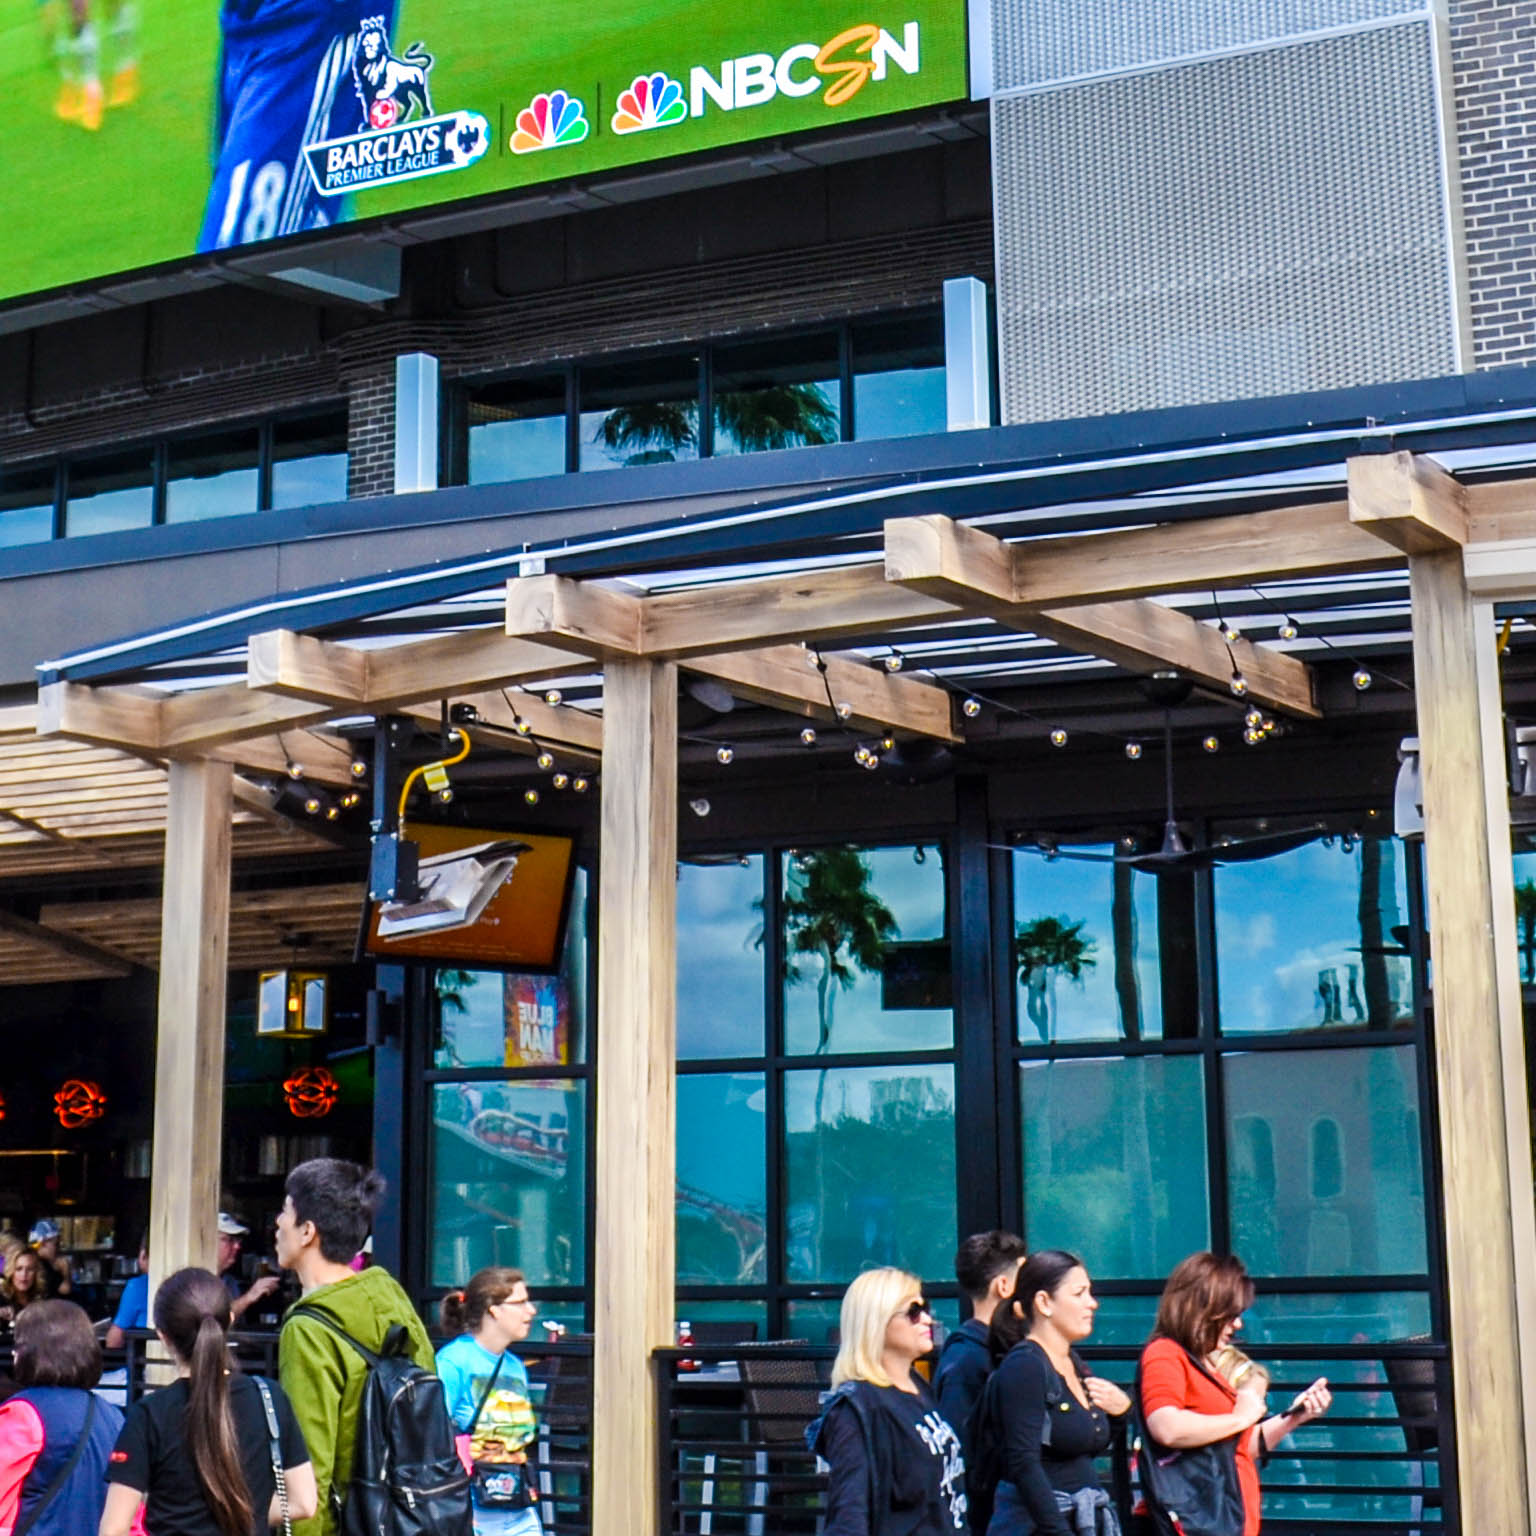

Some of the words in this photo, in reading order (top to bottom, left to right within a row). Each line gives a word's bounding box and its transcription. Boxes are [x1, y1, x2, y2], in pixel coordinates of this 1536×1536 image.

[689, 20, 920, 106] NBCSN
[325, 163, 384, 188] PREMIER
[386, 150, 440, 175] LEAGUE
[326, 124, 441, 173] BARCLAYS
[215, 159, 288, 250] 18
